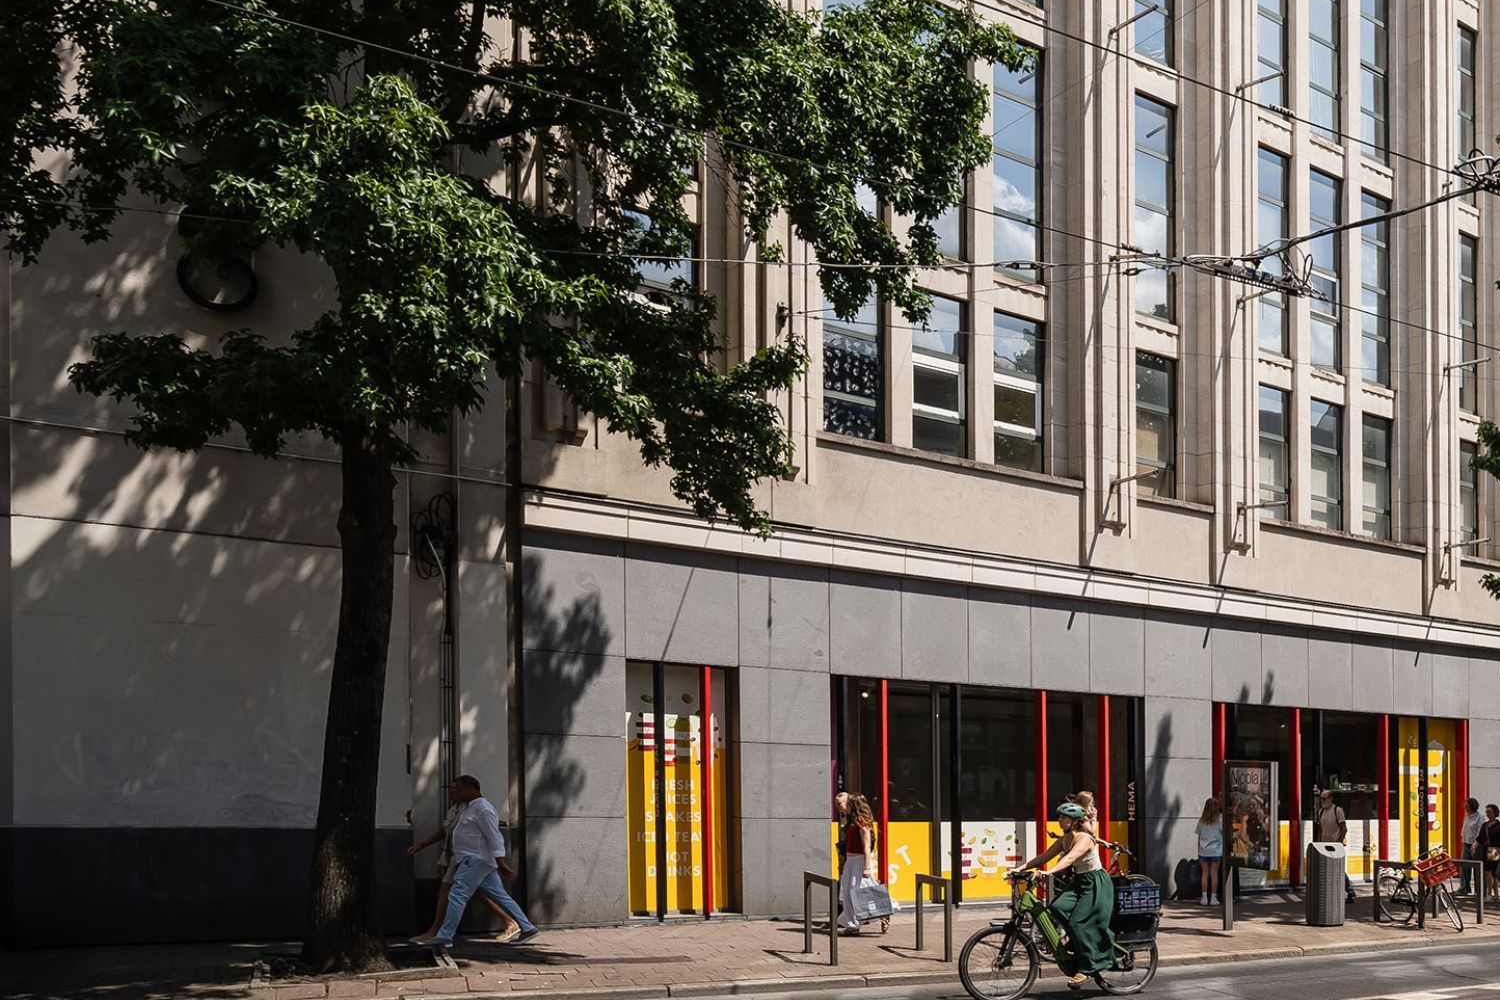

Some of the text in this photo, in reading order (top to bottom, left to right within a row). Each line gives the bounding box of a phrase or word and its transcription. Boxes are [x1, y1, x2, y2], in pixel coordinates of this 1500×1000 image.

[651, 779, 695, 791] ESH
[650, 793, 697, 805] JICES
[1128, 781, 1136, 821] HEMA
[645, 811, 701, 822] SAKES
[648, 865, 701, 877] DINKS
